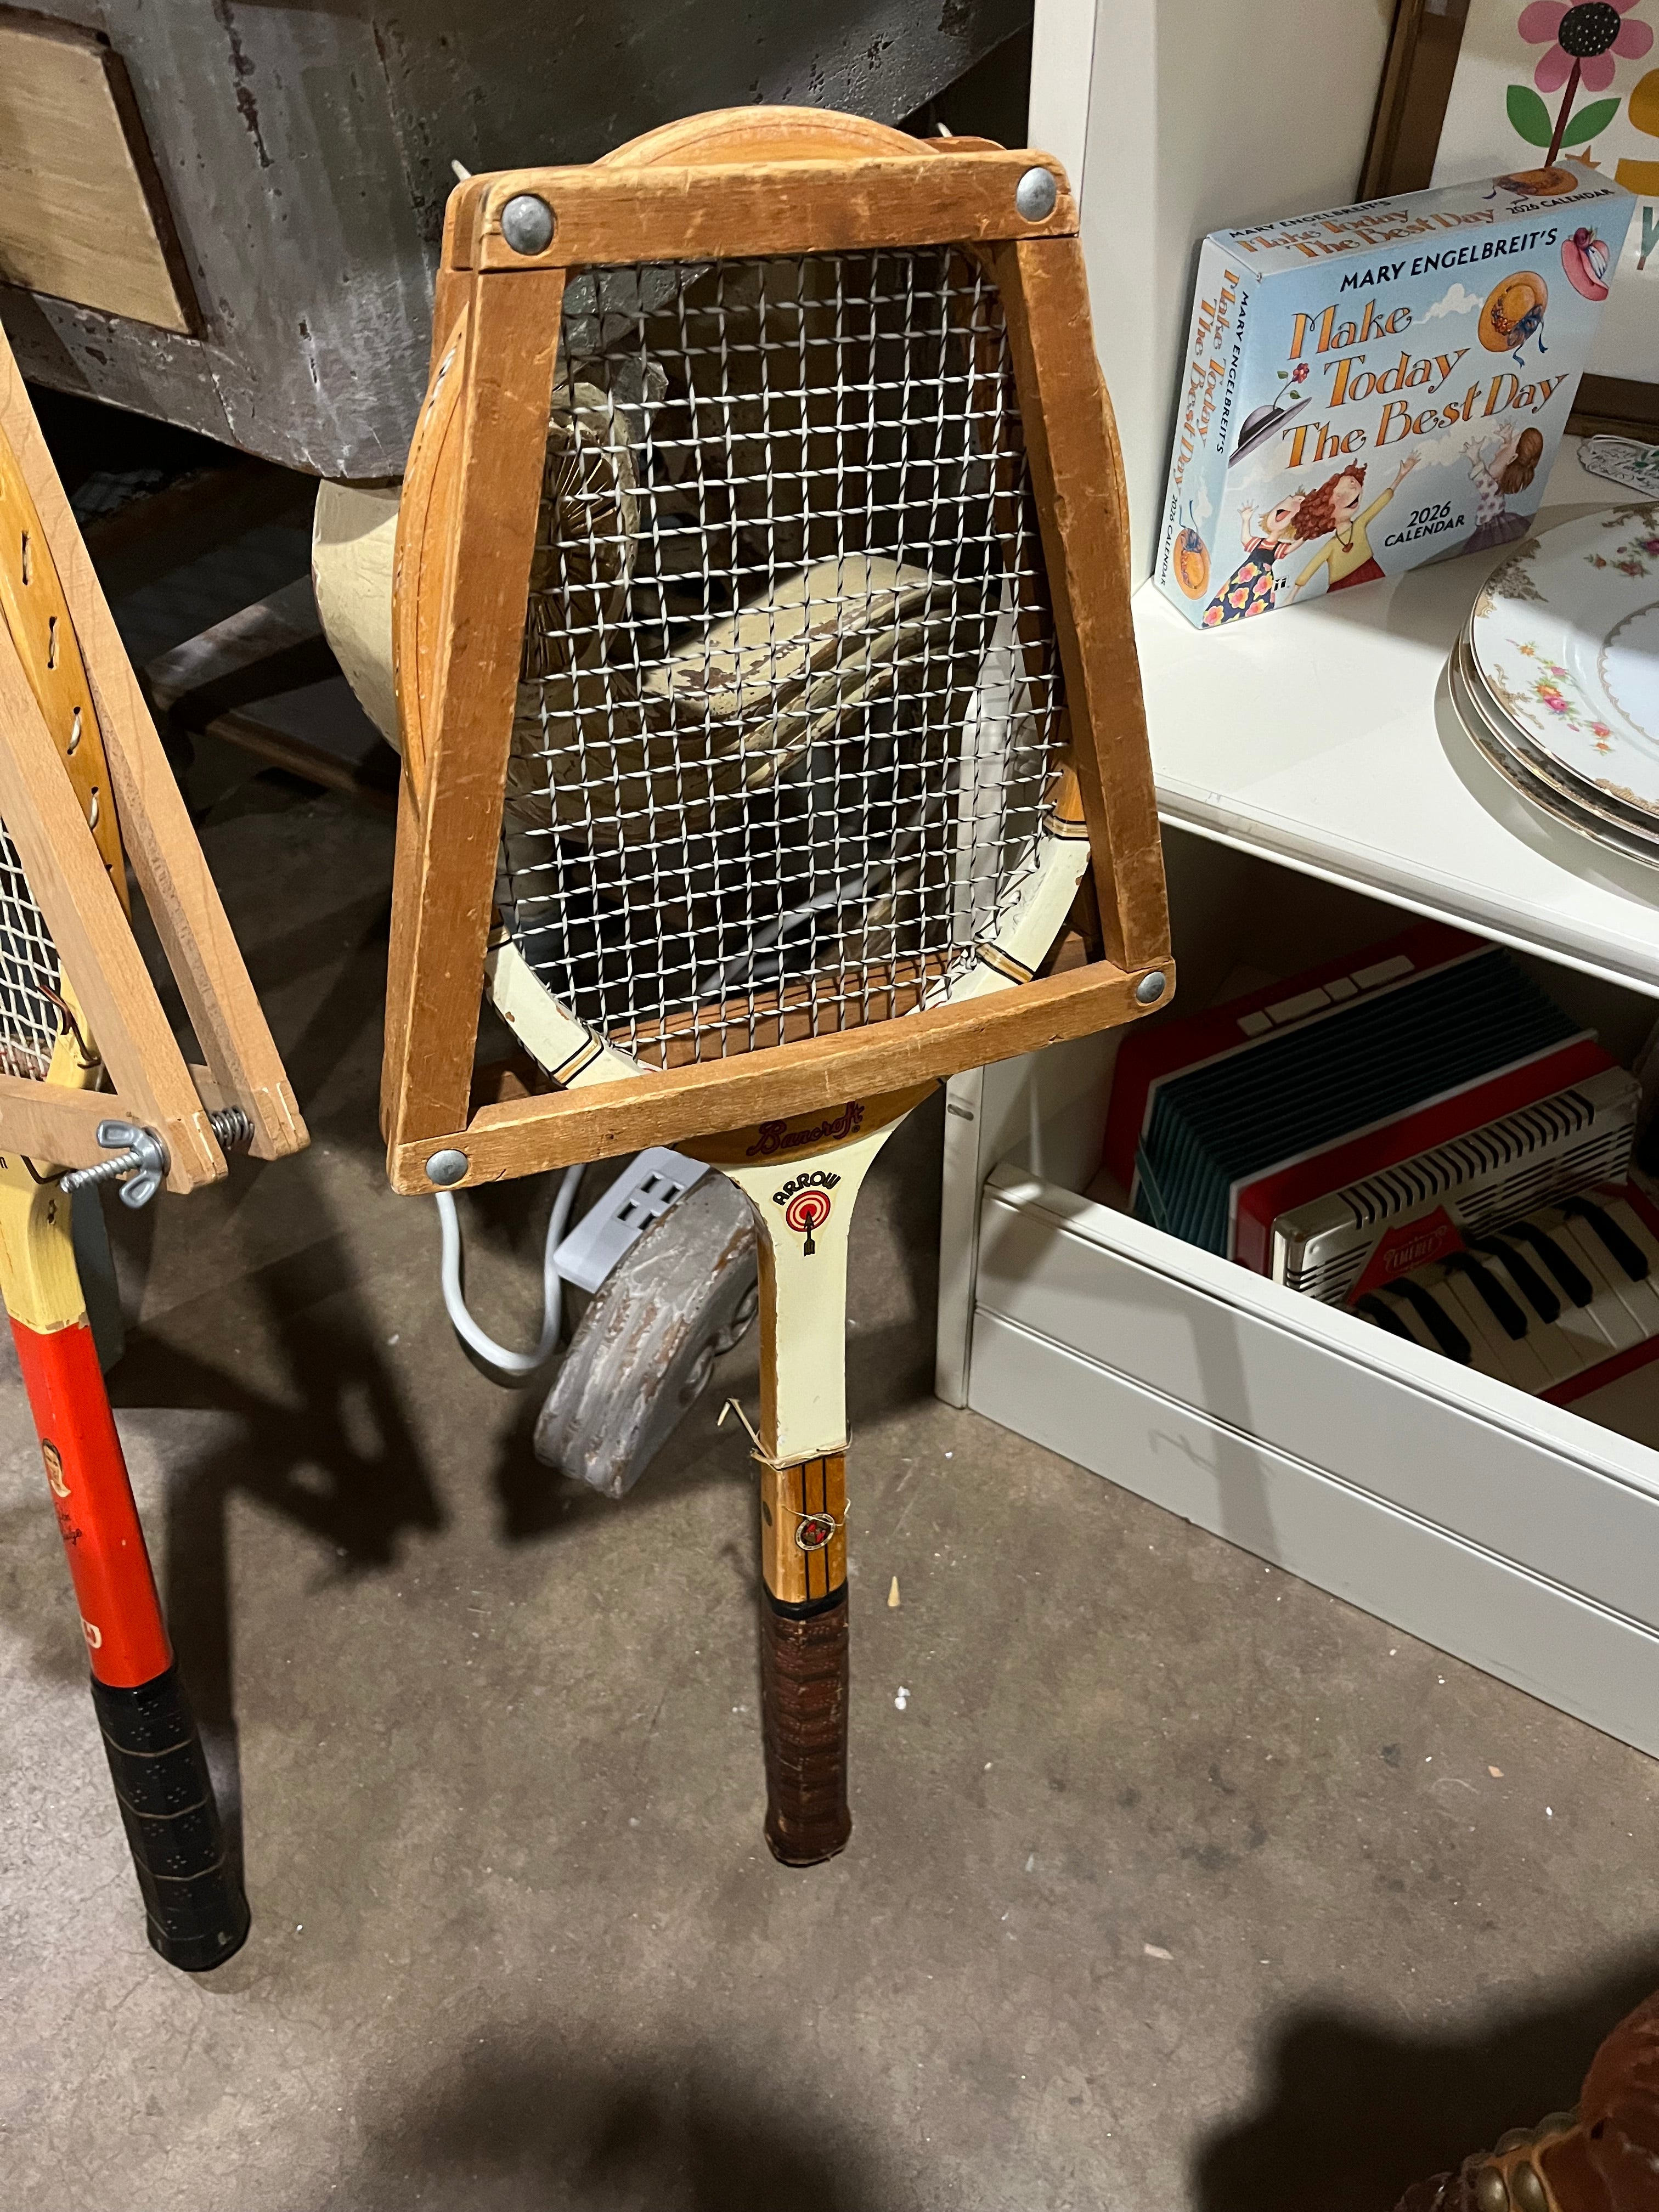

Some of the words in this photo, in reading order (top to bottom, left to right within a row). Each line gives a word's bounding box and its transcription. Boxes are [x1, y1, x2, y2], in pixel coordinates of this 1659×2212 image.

[1229, 223, 1274, 239] MARY
[1279, 200, 1392, 228] ENGELBREIT'S
[1235, 230, 1322, 253] Make
[1312, 208, 1409, 234] Today
[1506, 202, 1539, 215] 2026
[1540, 188, 1616, 207] CALENDAR
[1284, 239, 1361, 258] The
[1352, 217, 1437, 245] Best
[1430, 209, 1495, 228] Day
[1340, 261, 1406, 292] MARY
[1410, 227, 1558, 277] ENGELBREIT'S
[1194, 298, 1218, 357] The
[1212, 268, 1241, 350] Make
[1235, 290, 1250, 343] MARY
[1287, 298, 1413, 361] Make
[1183, 360, 1207, 439] Best
[1196, 356, 1227, 449] Today
[1216, 343, 1242, 455] ENGELBREIT'S
[1323, 347, 1472, 409] Today
[1282, 420, 1367, 469] The
[1373, 380, 1482, 448] Best
[1480, 373, 1570, 419] Day
[1173, 435, 1195, 497] Day
[1169, 493, 1178, 523] 2026
[1384, 514, 1465, 547] CALENDAR
[1407, 500, 1452, 528] 2026
[1160, 524, 1173, 586] CALENDAR
[746, 1099, 865, 1156] Bancroft
[772, 1170, 842, 1206] ARROW
